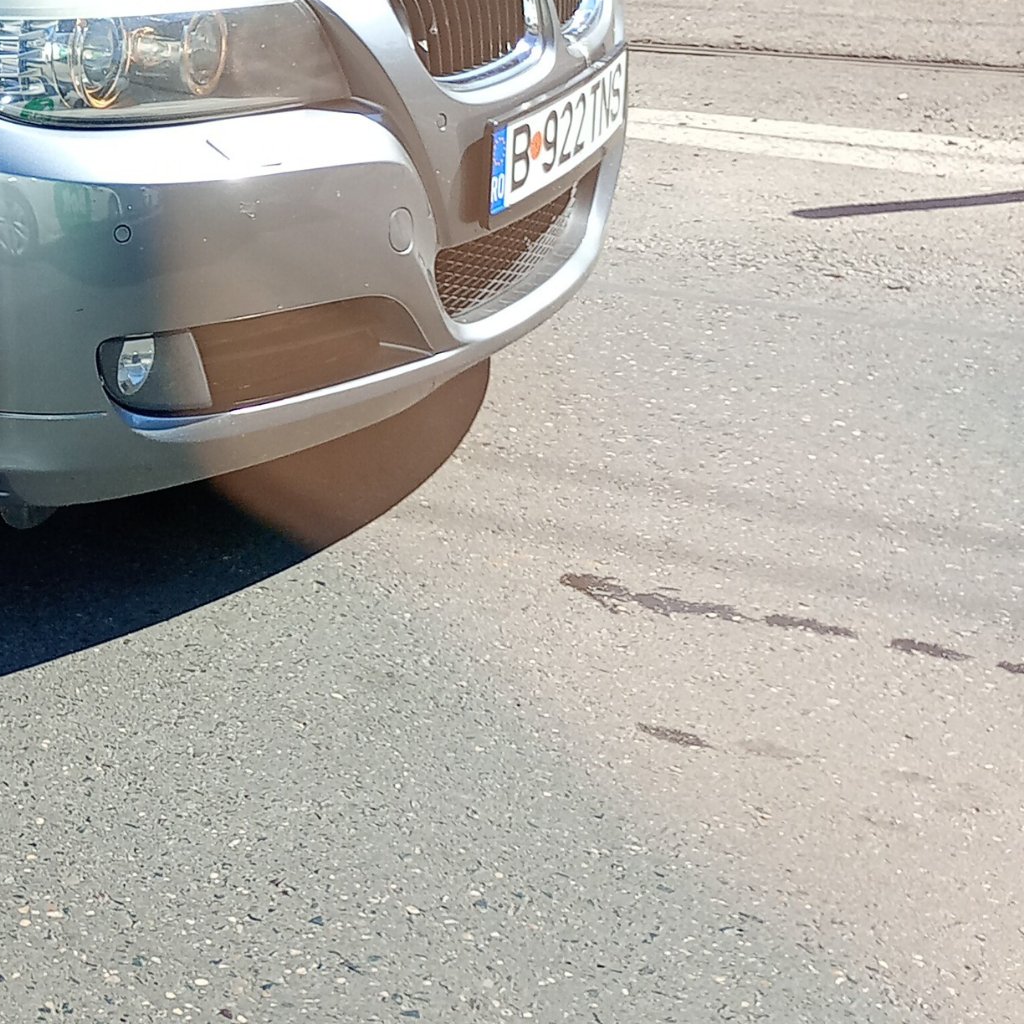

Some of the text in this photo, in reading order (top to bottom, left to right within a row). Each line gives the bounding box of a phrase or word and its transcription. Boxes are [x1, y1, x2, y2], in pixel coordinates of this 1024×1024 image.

[510, 62, 622, 193] B 922 TNS
[490, 173, 506, 203] RO
